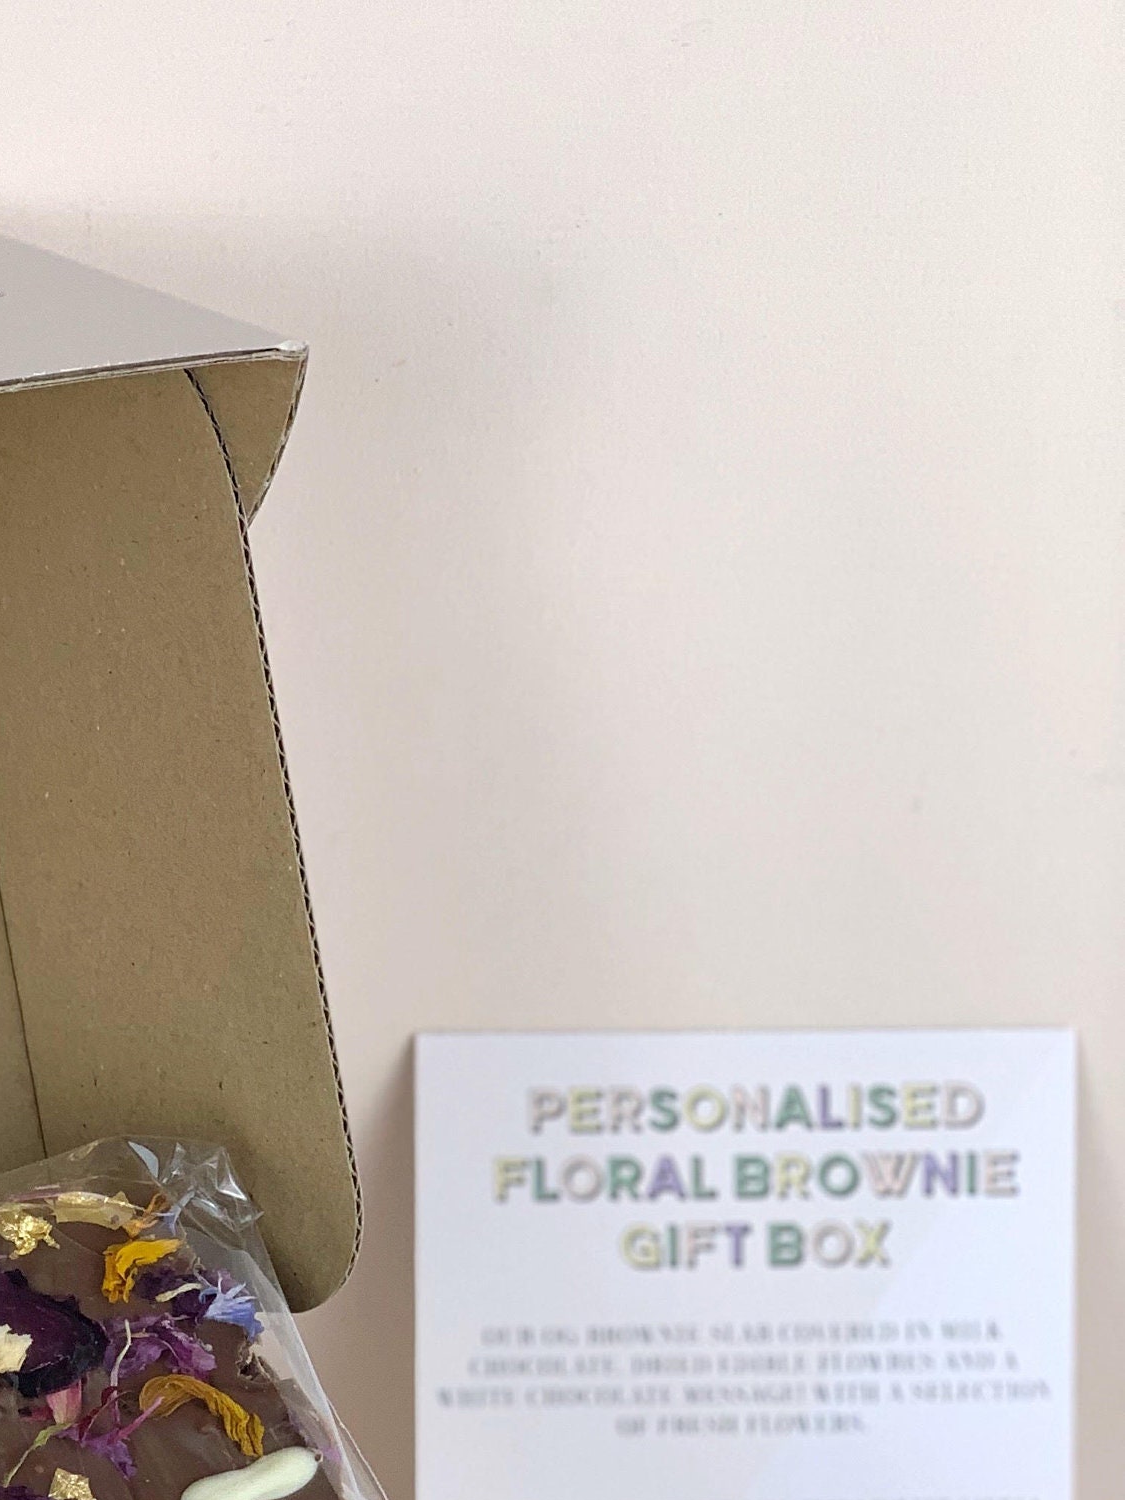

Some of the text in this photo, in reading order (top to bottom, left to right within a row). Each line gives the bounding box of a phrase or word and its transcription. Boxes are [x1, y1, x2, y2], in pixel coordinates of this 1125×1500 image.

[528, 1084, 985, 1134] PERSONALISED
[492, 1151, 1022, 1203] FLORAL BROWNIE
[622, 1220, 892, 1270] GIFT BOX
